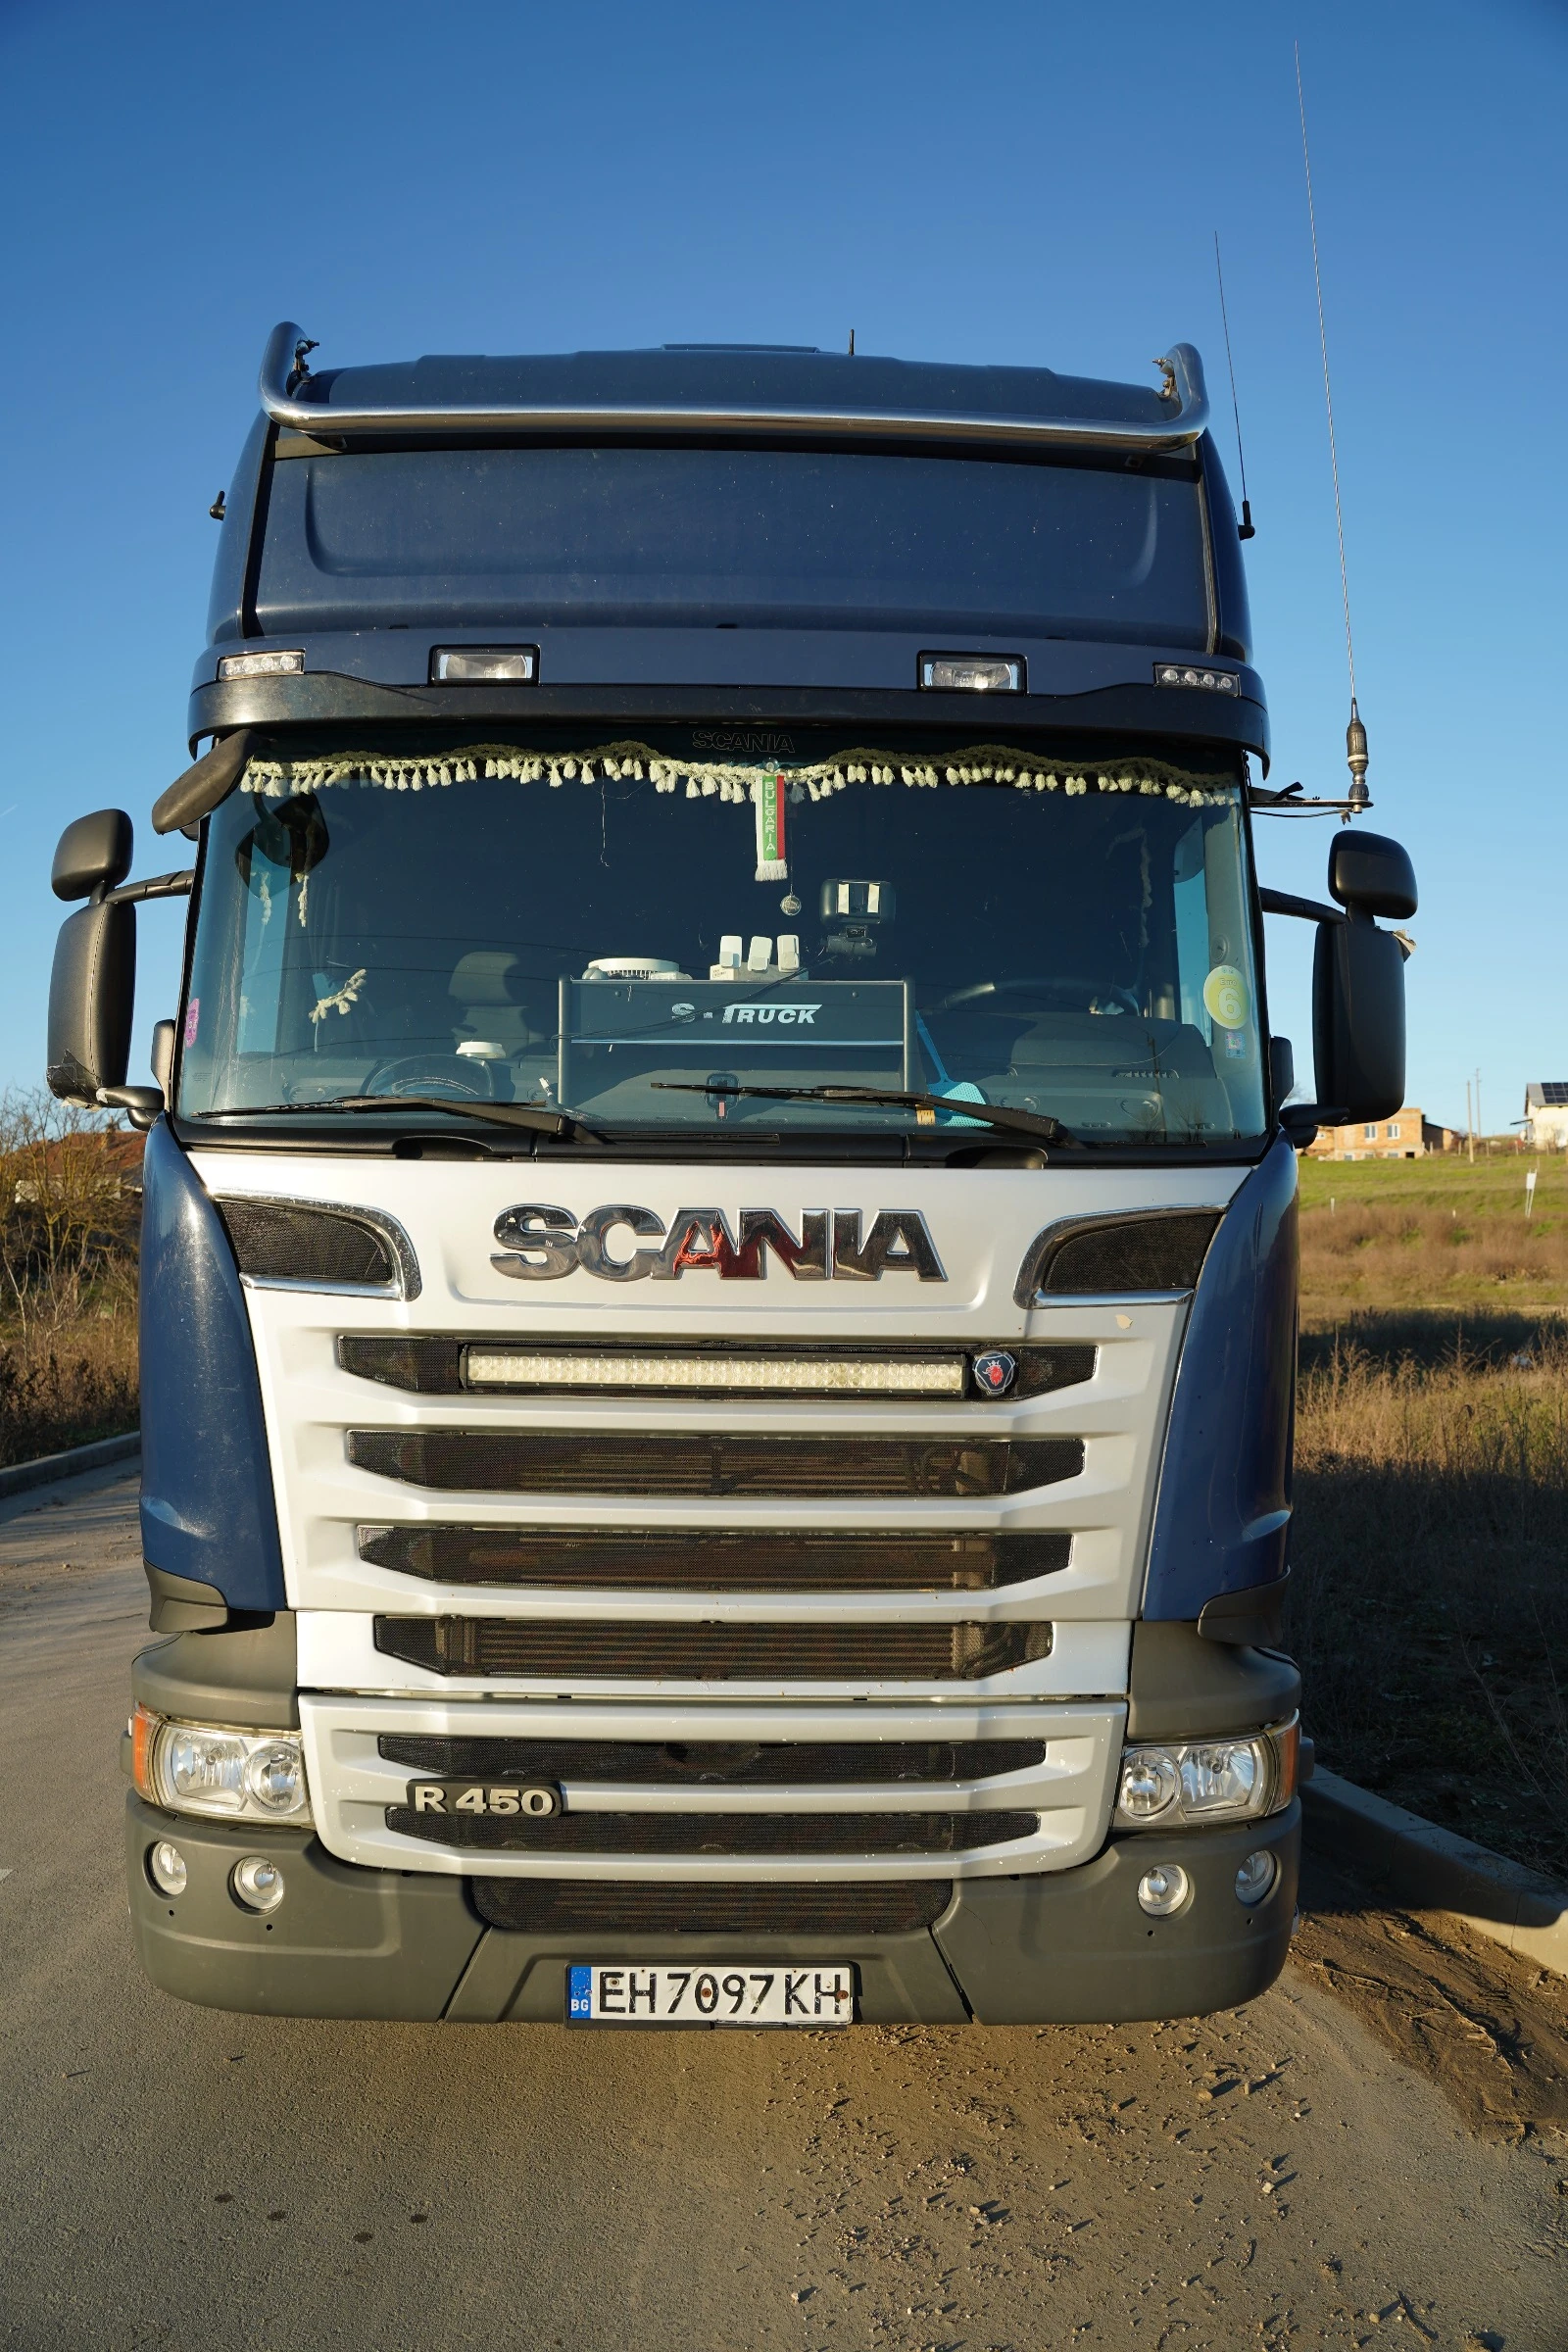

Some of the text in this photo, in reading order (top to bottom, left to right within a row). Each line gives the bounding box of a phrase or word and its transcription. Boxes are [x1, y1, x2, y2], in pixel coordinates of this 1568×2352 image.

[692, 730, 796, 754] SCANIA
[764, 781, 776, 852] BULGARIA
[1217, 986, 1242, 1021] 6
[489, 1202, 949, 1283] SCANIA
[415, 1786, 554, 1817] R 450
[570, 1998, 589, 2012] BG
